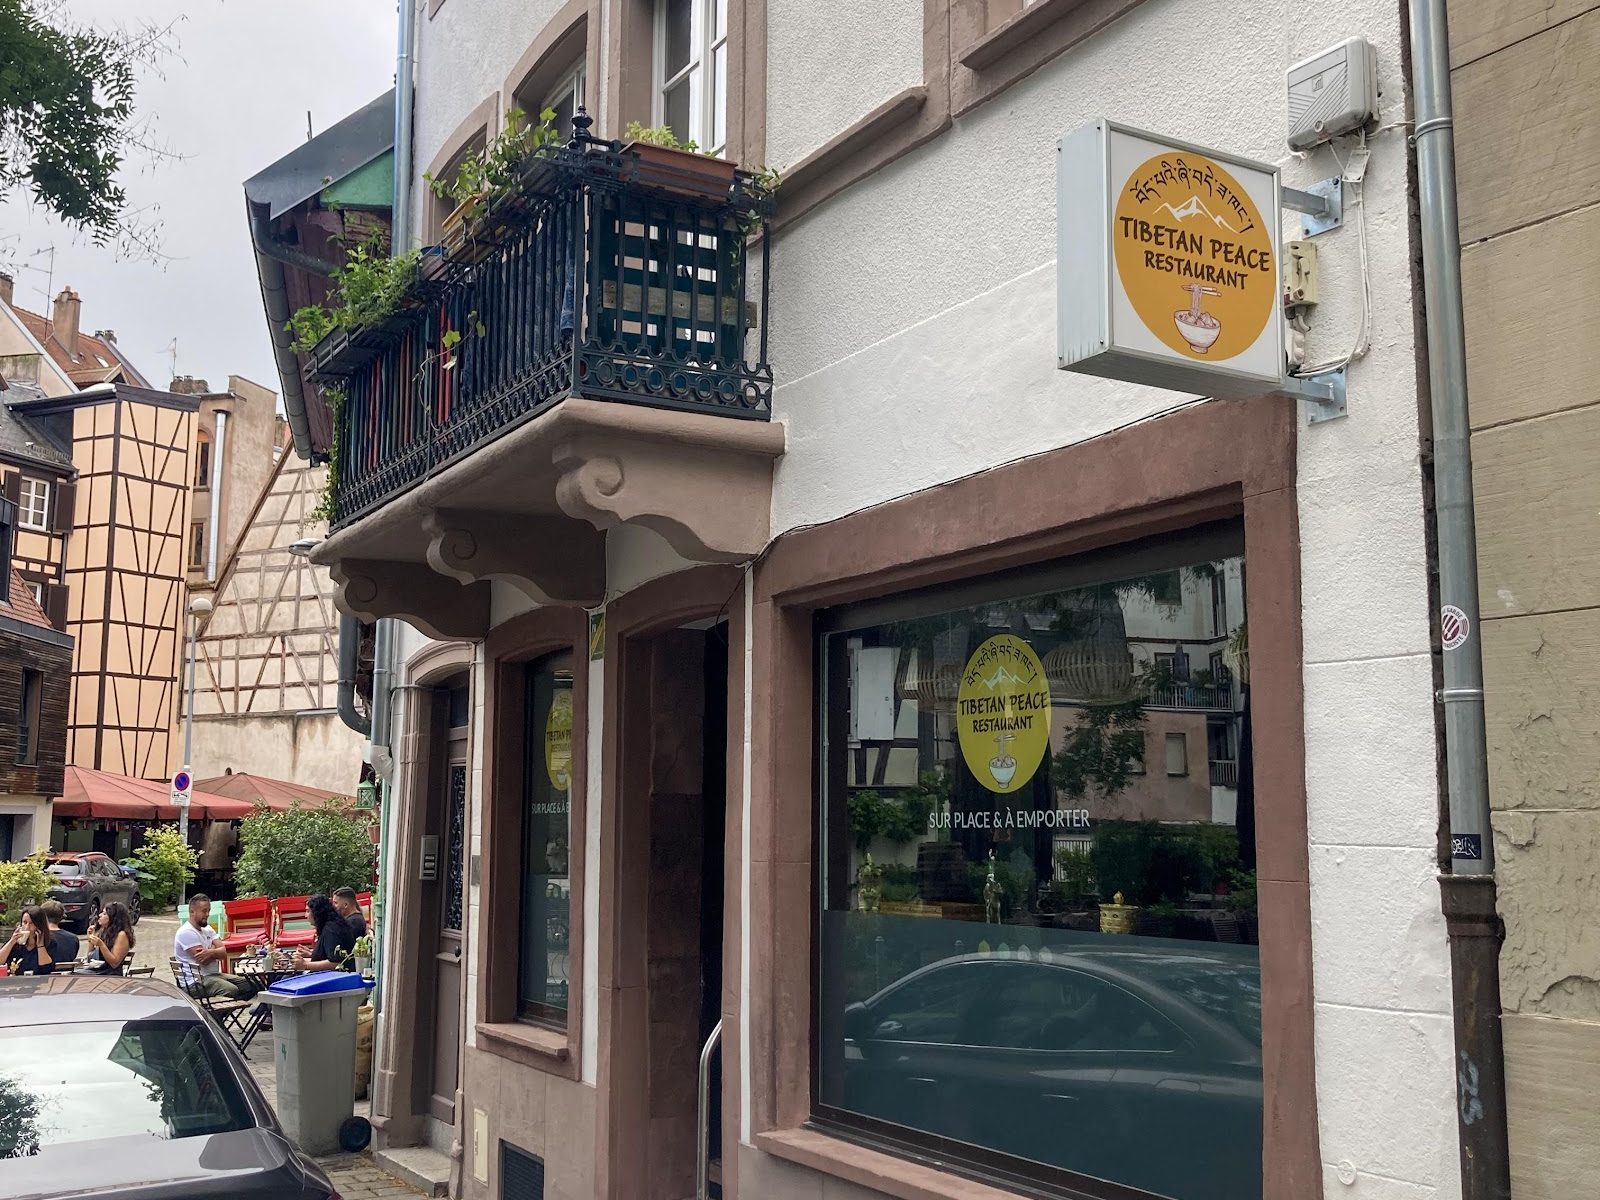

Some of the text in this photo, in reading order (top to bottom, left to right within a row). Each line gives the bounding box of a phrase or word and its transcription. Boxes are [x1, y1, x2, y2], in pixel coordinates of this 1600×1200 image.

[1119, 216, 1270, 272] TIBETAN PEACE
[1144, 250, 1249, 290] RESTAURANT
[959, 691, 1048, 716] TIBETAN PEACE
[972, 715, 1034, 733] RESTAURANT
[541, 802, 556, 814] PLACE
[929, 806, 1091, 829] SUR PLACE & À EMPORTER
